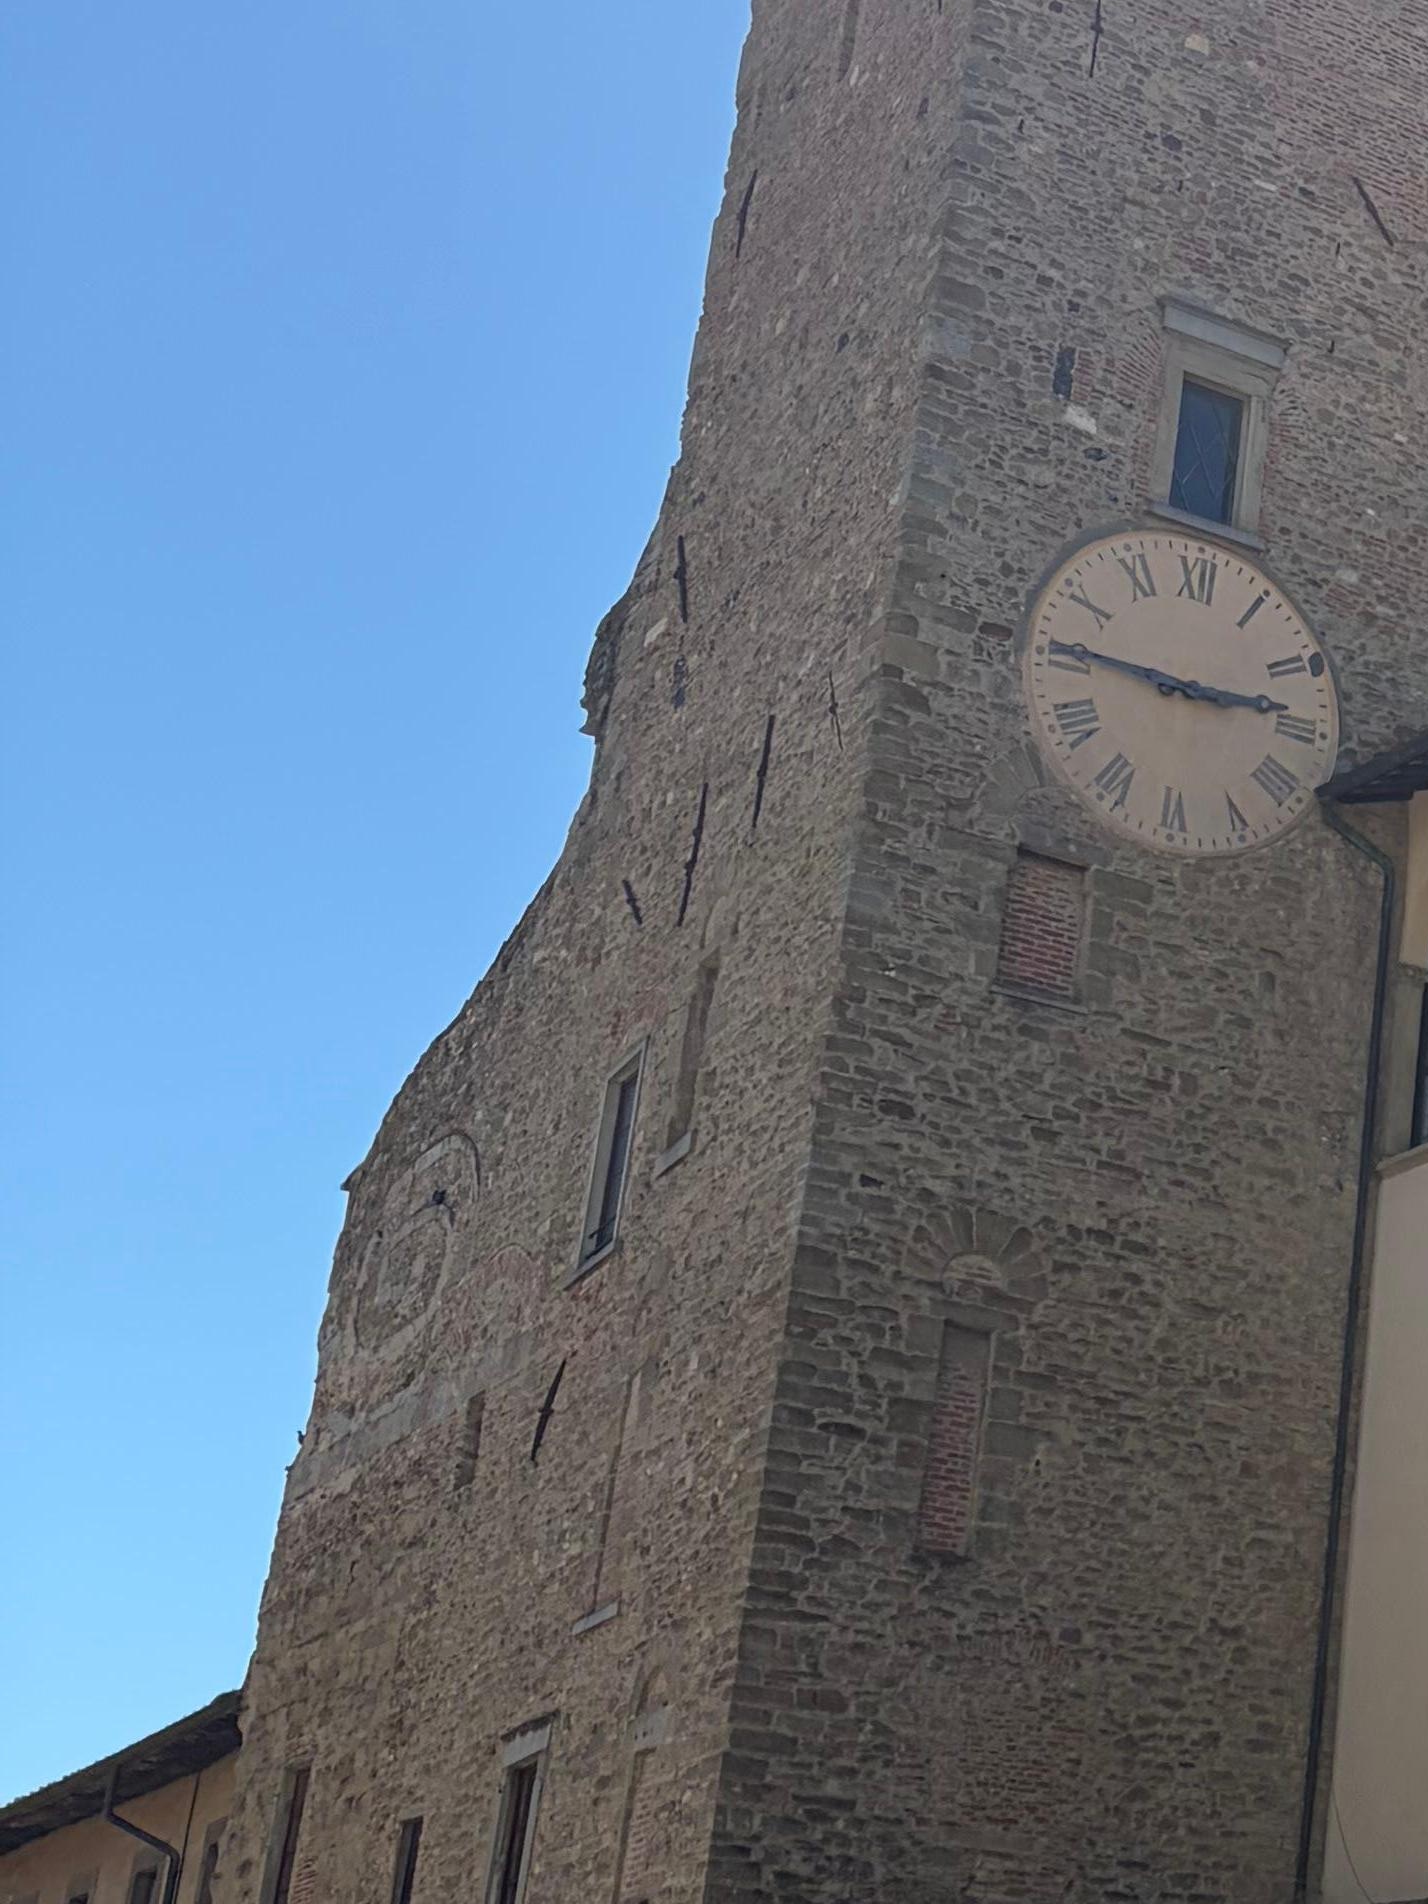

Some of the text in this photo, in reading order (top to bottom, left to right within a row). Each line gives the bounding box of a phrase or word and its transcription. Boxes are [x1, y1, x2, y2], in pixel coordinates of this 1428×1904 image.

[1117, 553, 1158, 603] XI
[1177, 554, 1218, 607] XII
[1069, 584, 1114, 632] X
[1236, 593, 1267, 631] I
[1266, 654, 1308, 680] II
[1053, 698, 1103, 752] VIII
[1274, 713, 1317, 746] III
[1094, 752, 1137, 810] VII
[1160, 785, 1189, 834] VI
[1224, 788, 1250, 833] V
